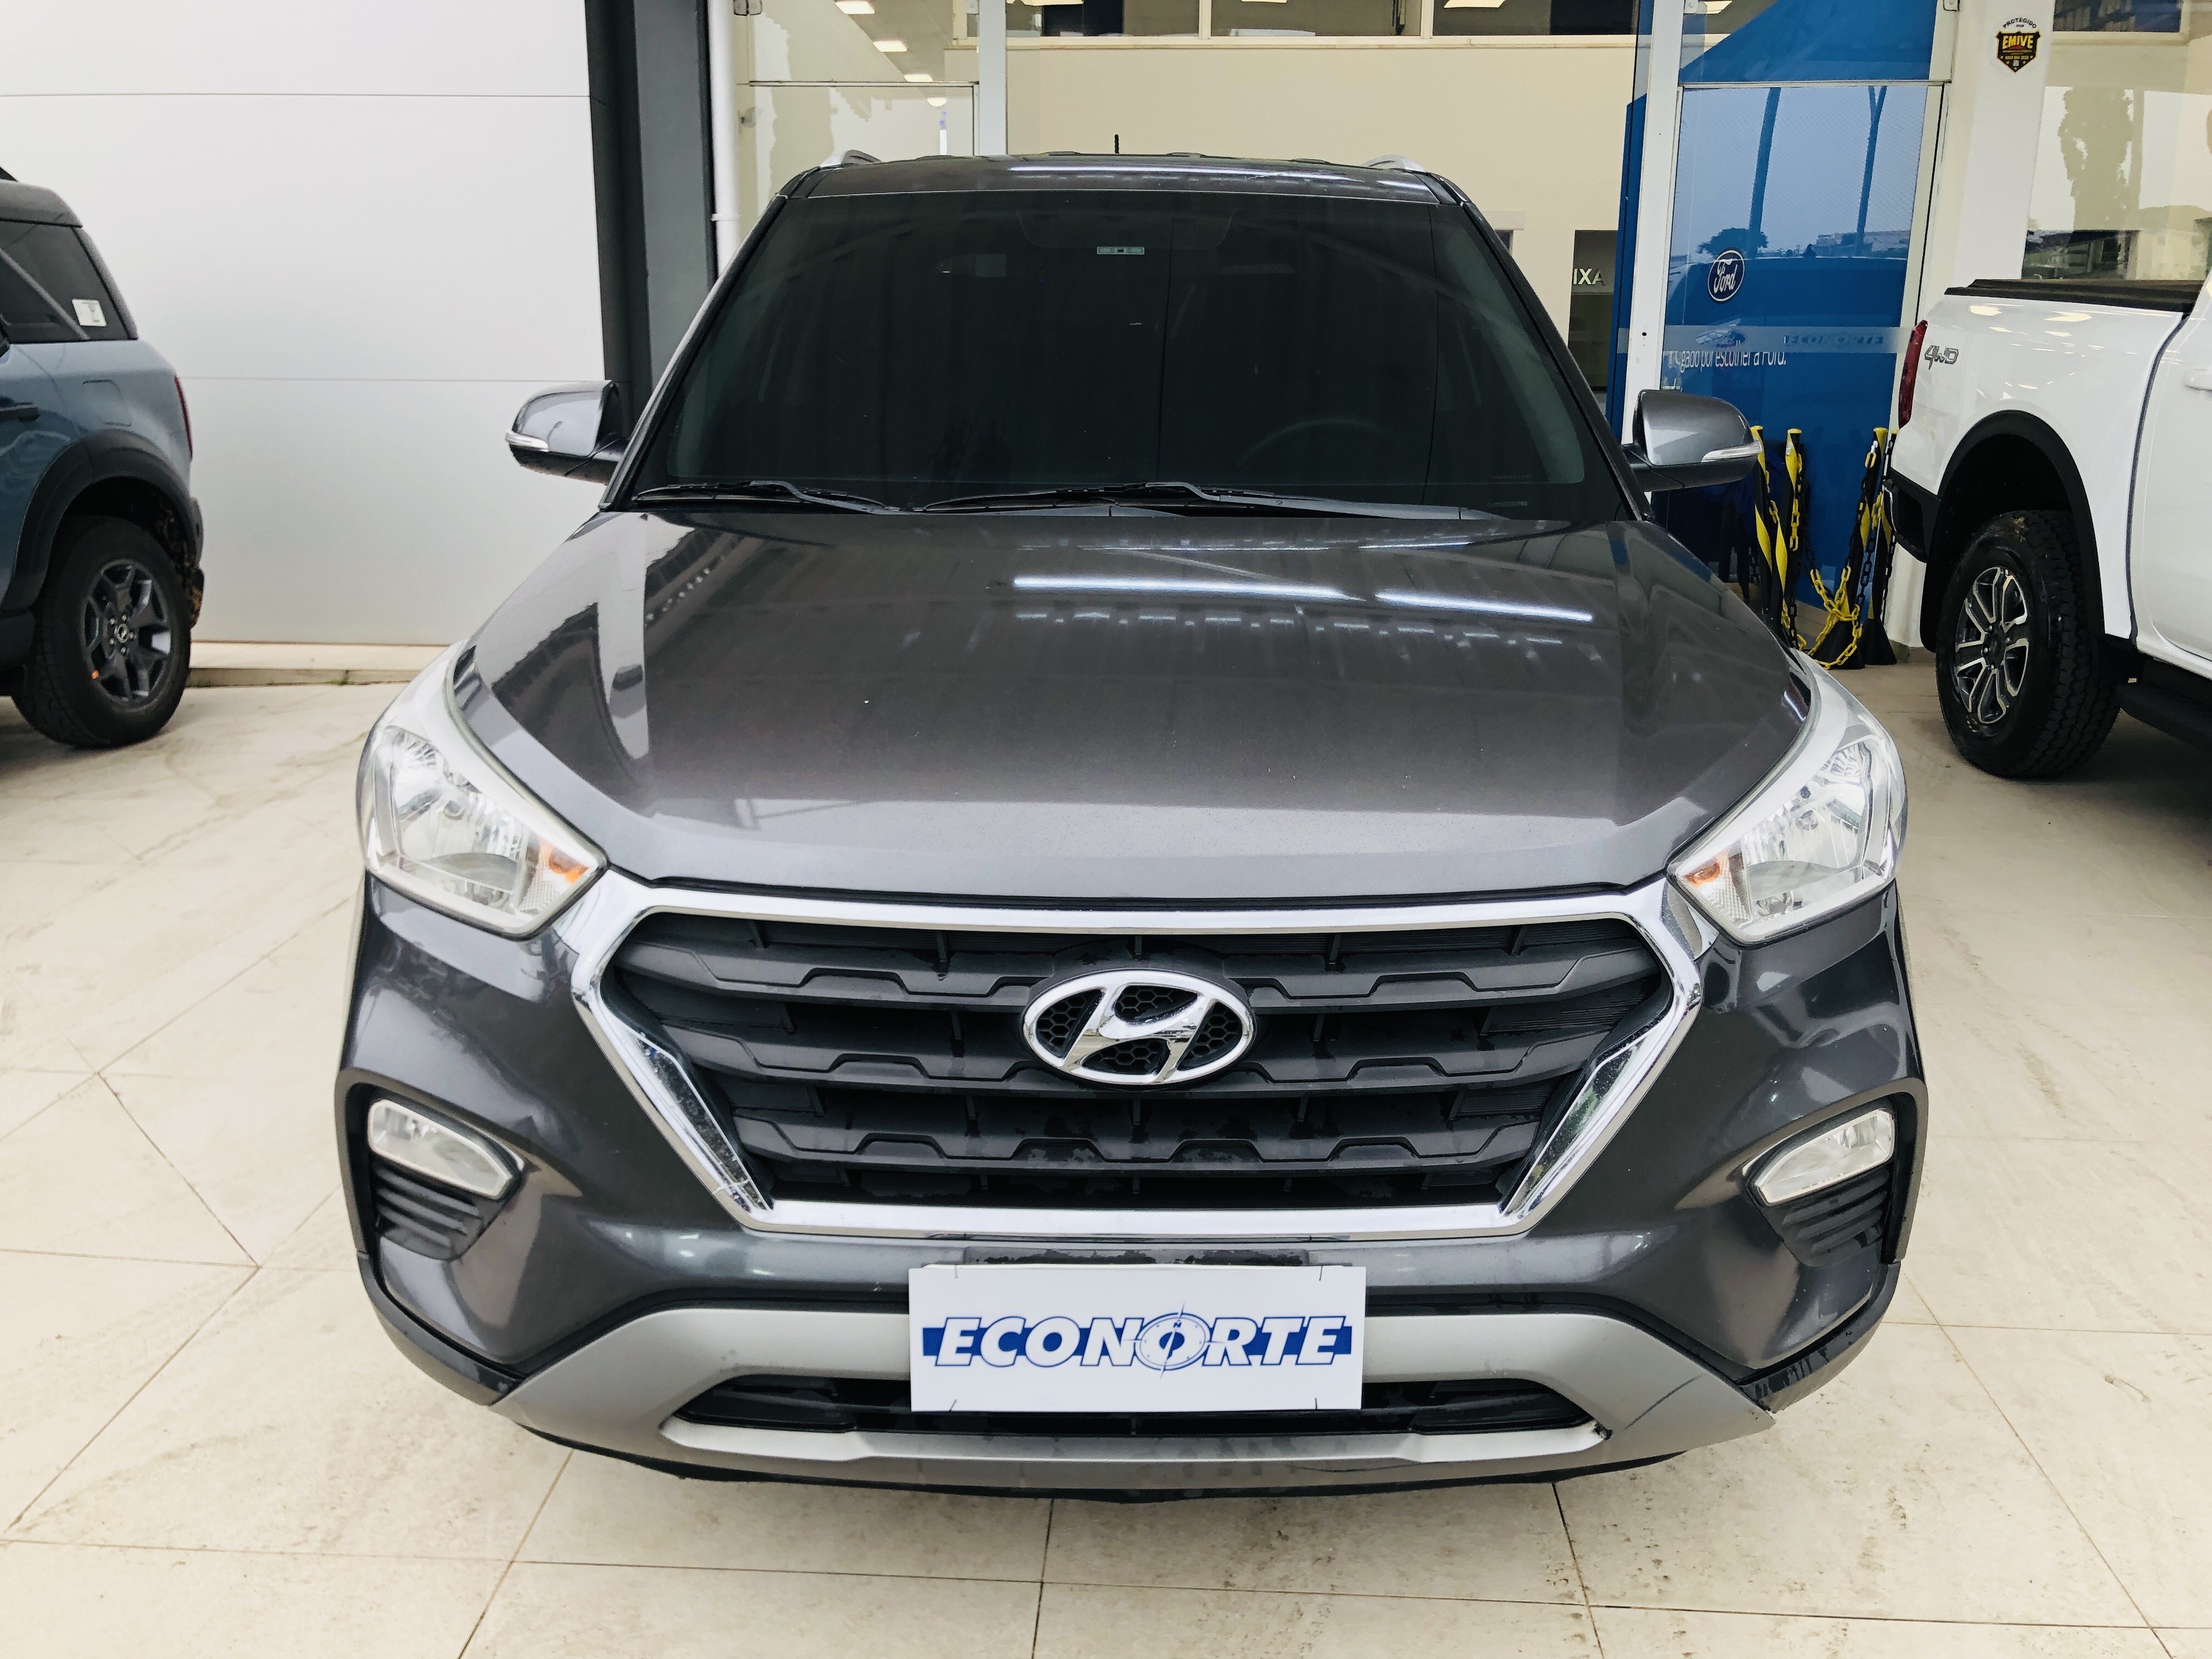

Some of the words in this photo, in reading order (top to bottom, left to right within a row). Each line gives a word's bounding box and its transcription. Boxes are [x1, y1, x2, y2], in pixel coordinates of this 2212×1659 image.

[2003, 18, 2036, 29] PROTEGIDO
[2002, 35, 2033, 49] EMIVE
[1713, 258, 1738, 294] Ford
[934, 1312, 1347, 1370] ECONORTE
